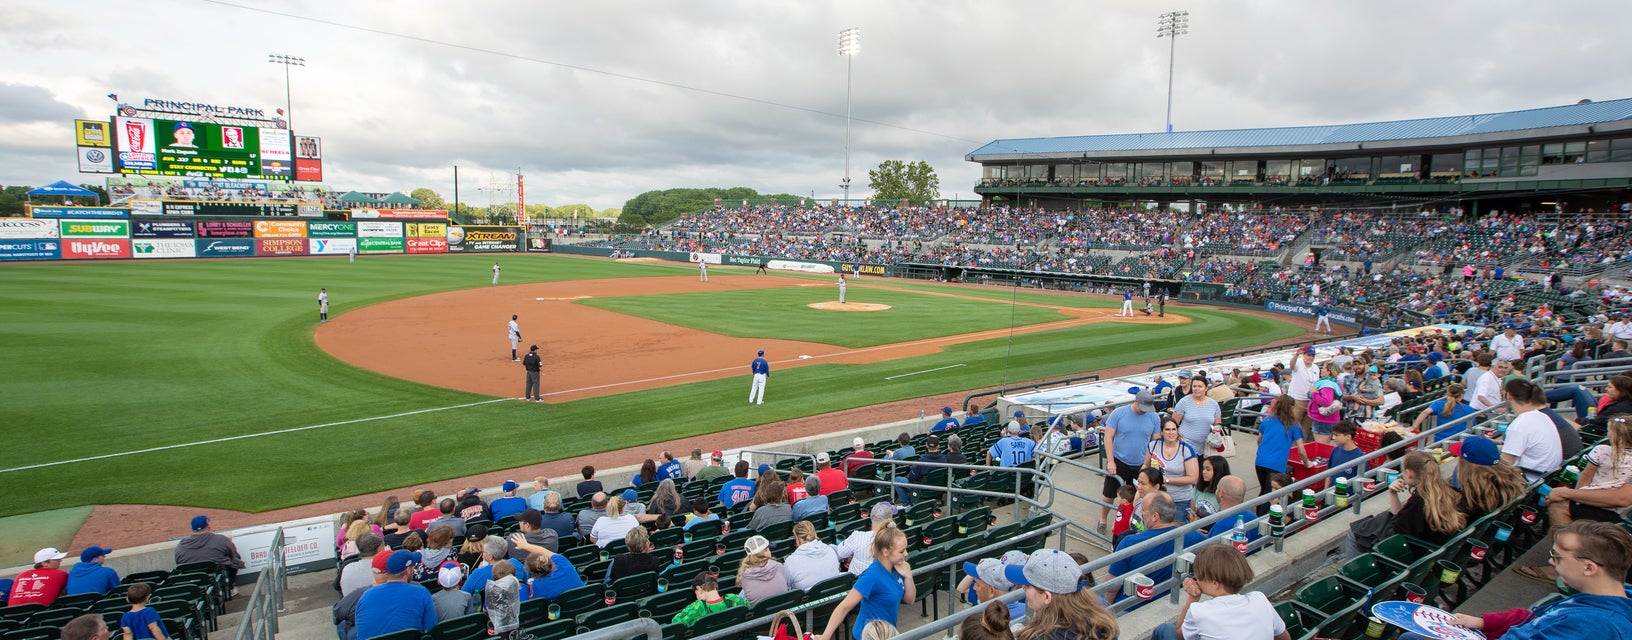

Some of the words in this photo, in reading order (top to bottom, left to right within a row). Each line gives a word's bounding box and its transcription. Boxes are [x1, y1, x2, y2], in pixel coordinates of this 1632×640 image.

[144, 98, 224, 114] PRINCIPAL
[228, 106, 264, 117] PARK
[68, 224, 121, 233] SUBWAY
[270, 221, 306, 229] Community
[309, 223, 355, 231] MERCYONE
[465, 231, 517, 241] XTREAM
[429, 240, 446, 248] Clips
[737, 256, 751, 265] Taylor
[841, 263, 885, 275] GUYCKLAW.COM
[1274, 302, 1298, 313] Principal
[1012, 450, 1026, 465] 10
[731, 490, 749, 505] 40
[250, 551, 268, 560] BRAD
[309, 542, 319, 550] CO.
